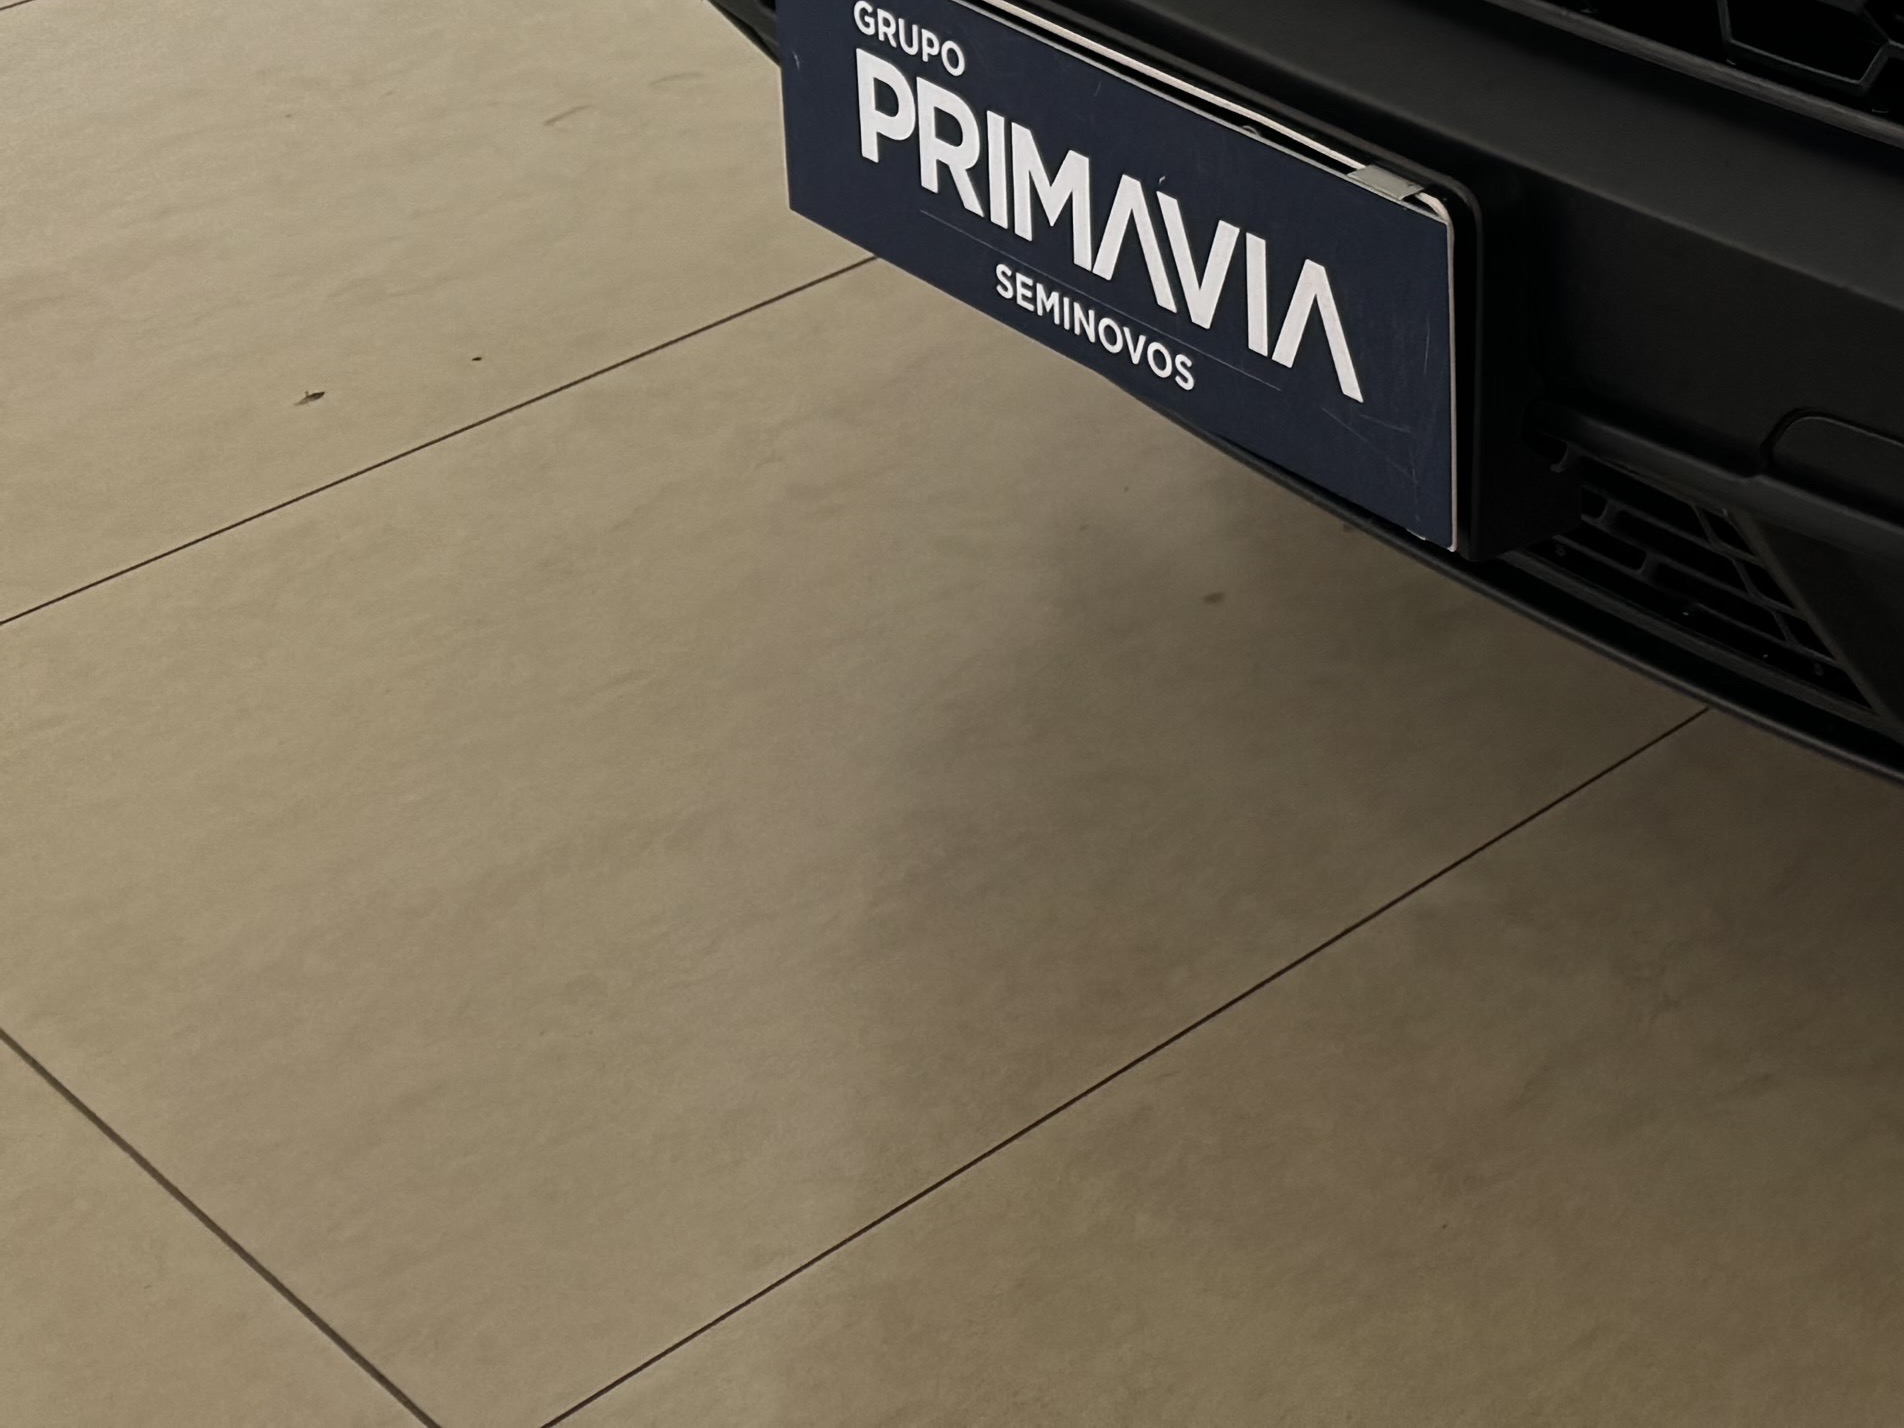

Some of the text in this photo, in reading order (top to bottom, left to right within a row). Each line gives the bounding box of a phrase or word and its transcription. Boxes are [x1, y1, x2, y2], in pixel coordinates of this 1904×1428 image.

[852, 0, 967, 78] GRUPO
[854, 46, 1364, 404] PRIMAVIA
[994, 262, 1196, 392] SEMINOVOS
